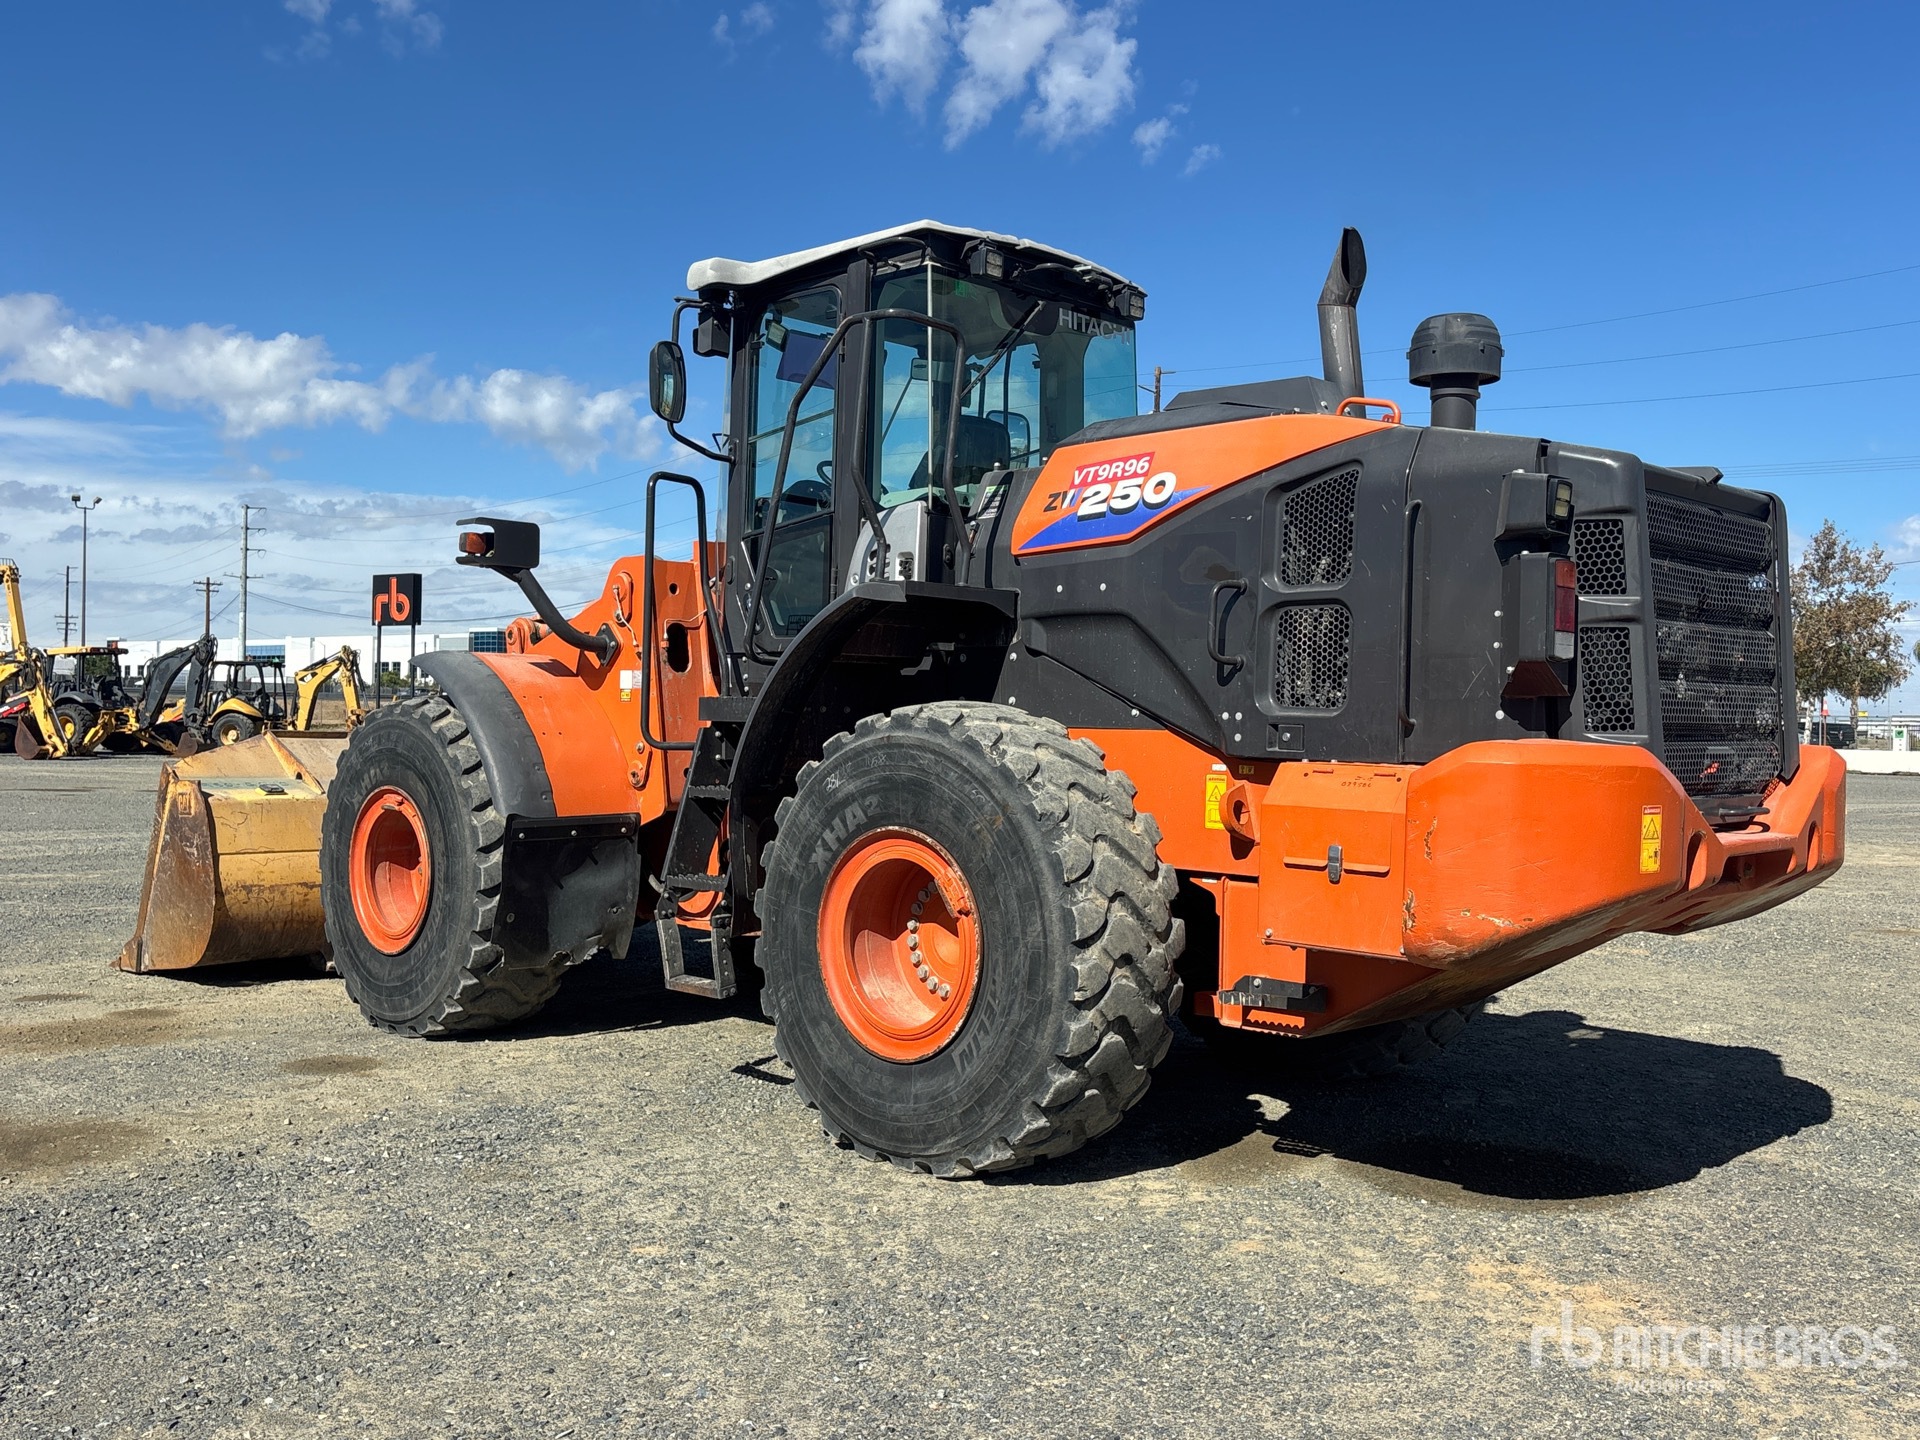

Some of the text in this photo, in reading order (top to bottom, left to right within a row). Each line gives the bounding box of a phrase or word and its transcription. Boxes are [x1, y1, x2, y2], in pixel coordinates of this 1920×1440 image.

[1059, 307, 1131, 345] HITACHI
[1074, 456, 1151, 486] VT9R96
[1077, 472, 1177, 522] 250
[374, 577, 410, 622] rb
